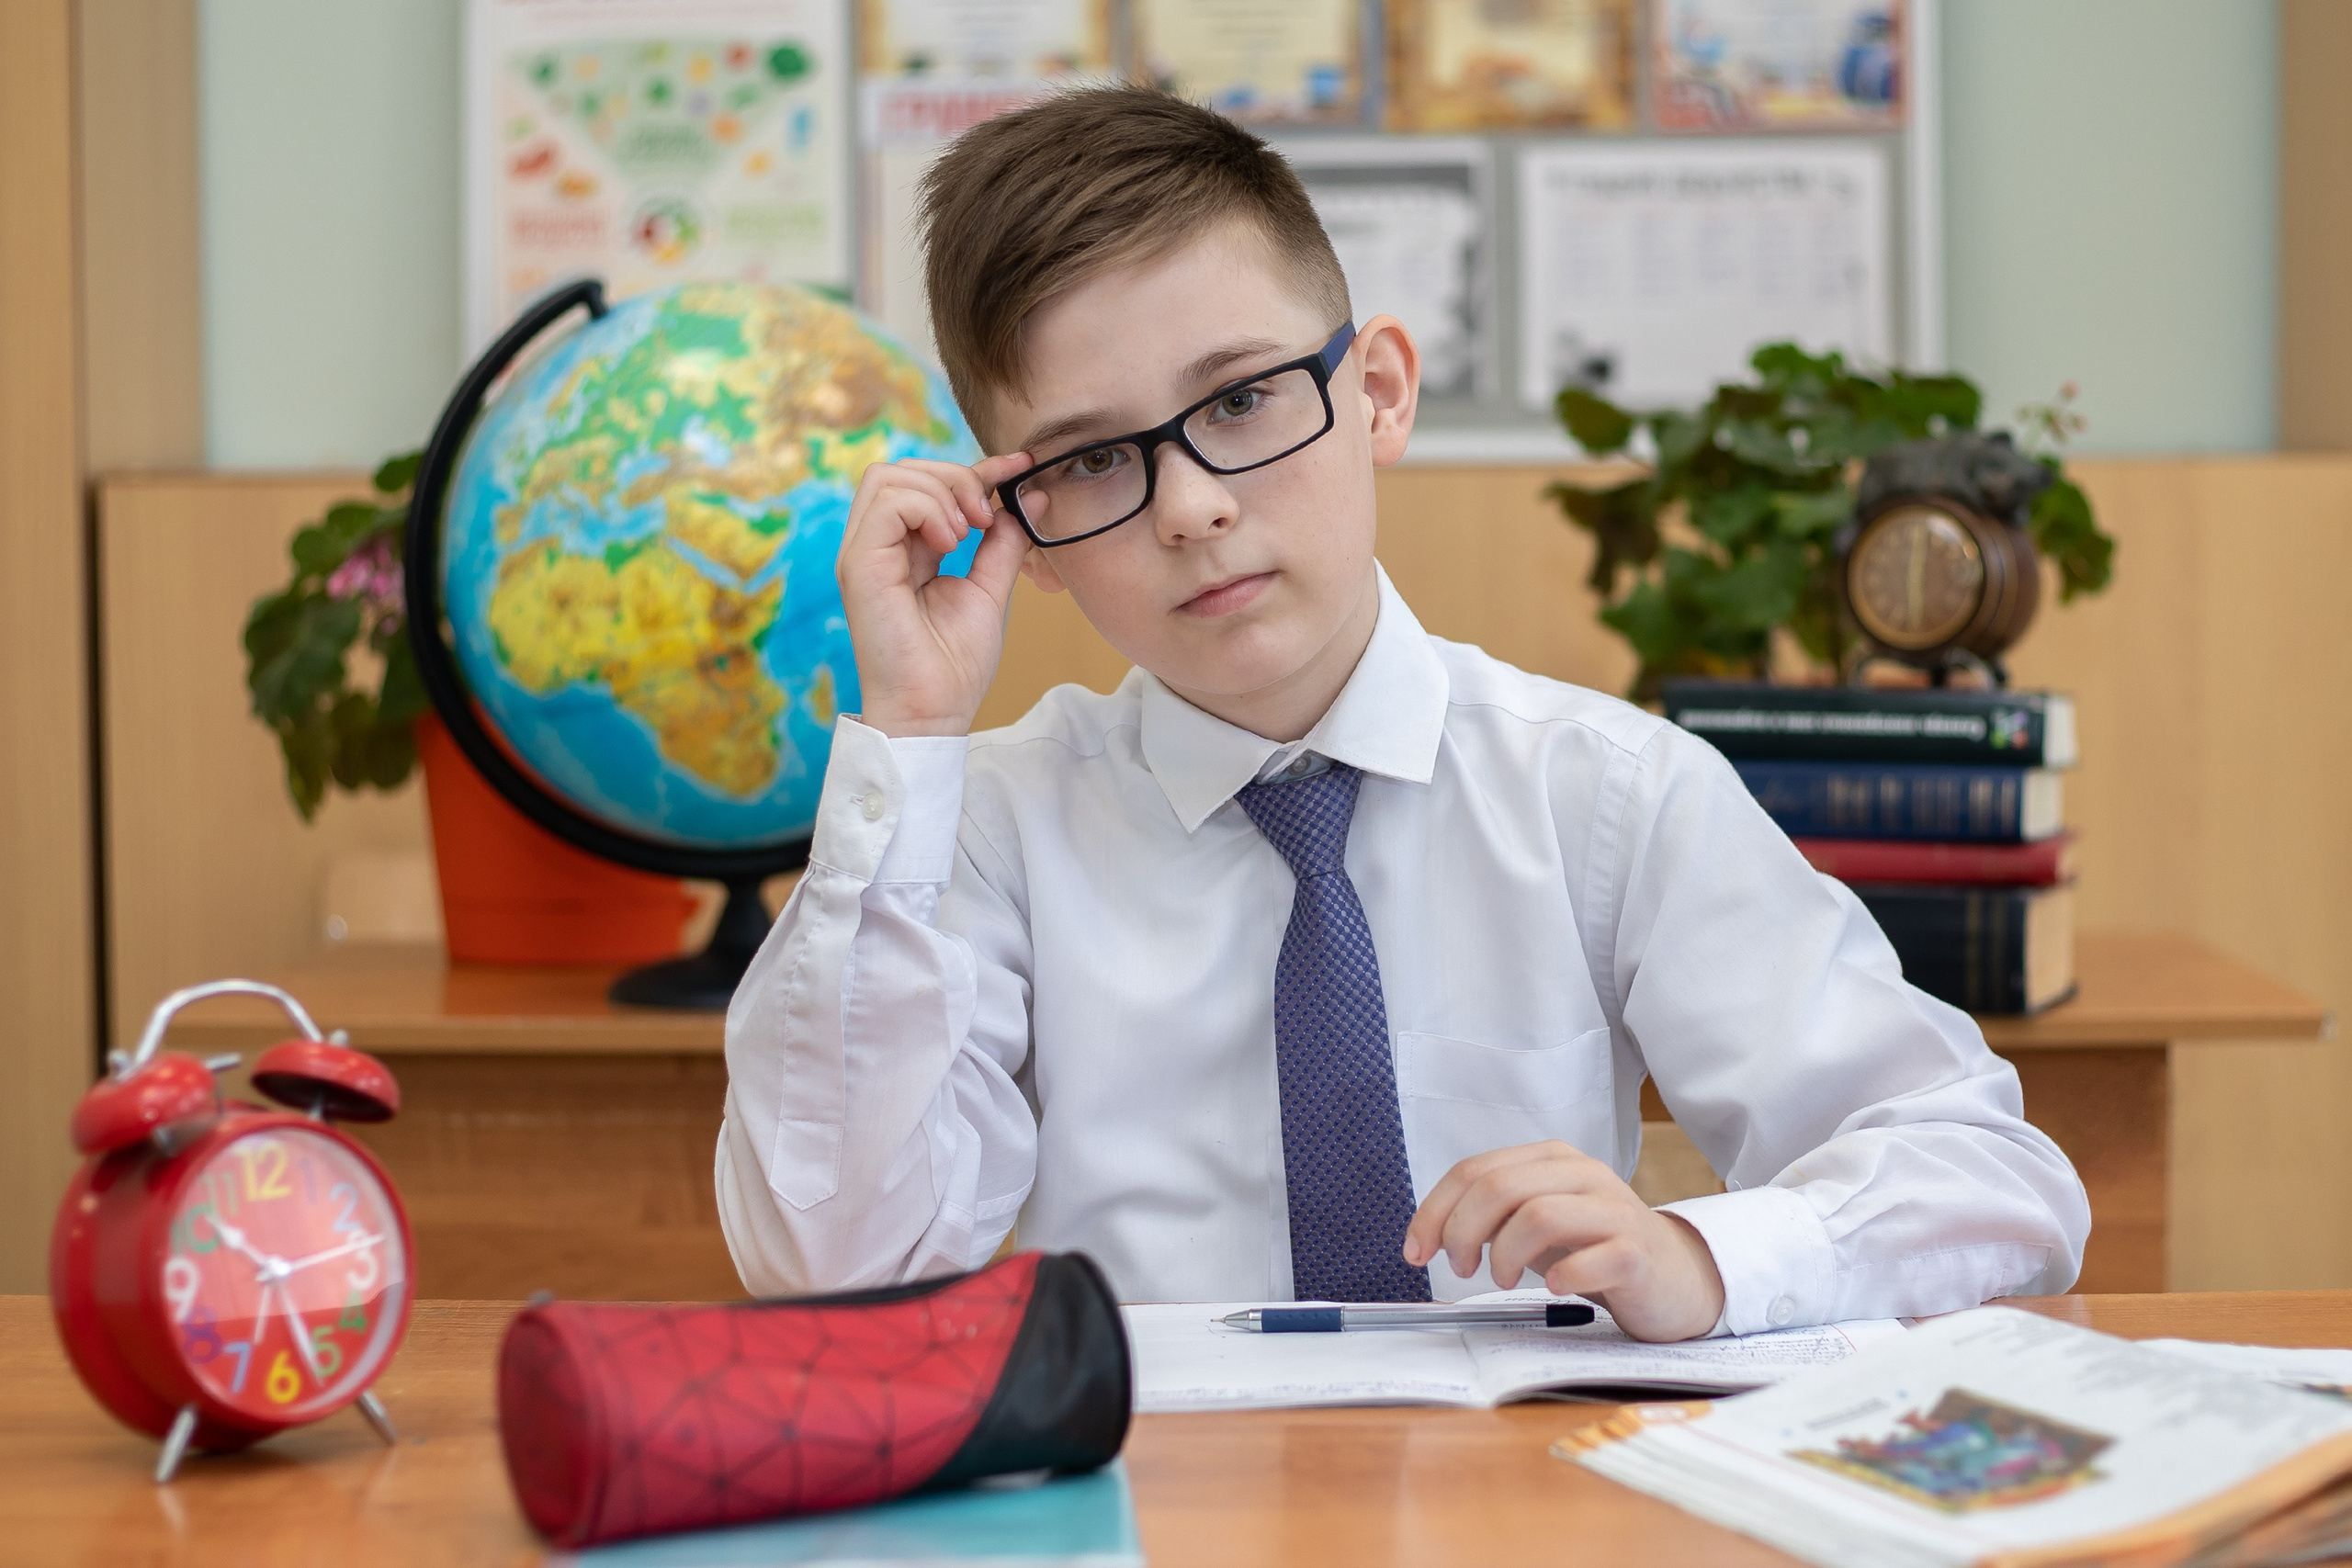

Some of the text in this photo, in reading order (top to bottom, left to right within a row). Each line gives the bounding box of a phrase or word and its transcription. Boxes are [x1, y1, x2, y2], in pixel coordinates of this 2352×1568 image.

[201, 1172, 240, 1216] 11
[232, 1140, 292, 1201] 12
[298, 1157, 318, 1203] 1
[171, 1203, 222, 1255] 10
[329, 1181, 361, 1232] 2
[346, 1228, 379, 1291] 3
[163, 1257, 200, 1323] 9
[339, 1288, 368, 1335] 4
[183, 1305, 222, 1365] 8
[311, 1325, 344, 1377] 5
[223, 1342, 252, 1394] 7
[266, 1348, 300, 1404] 6
